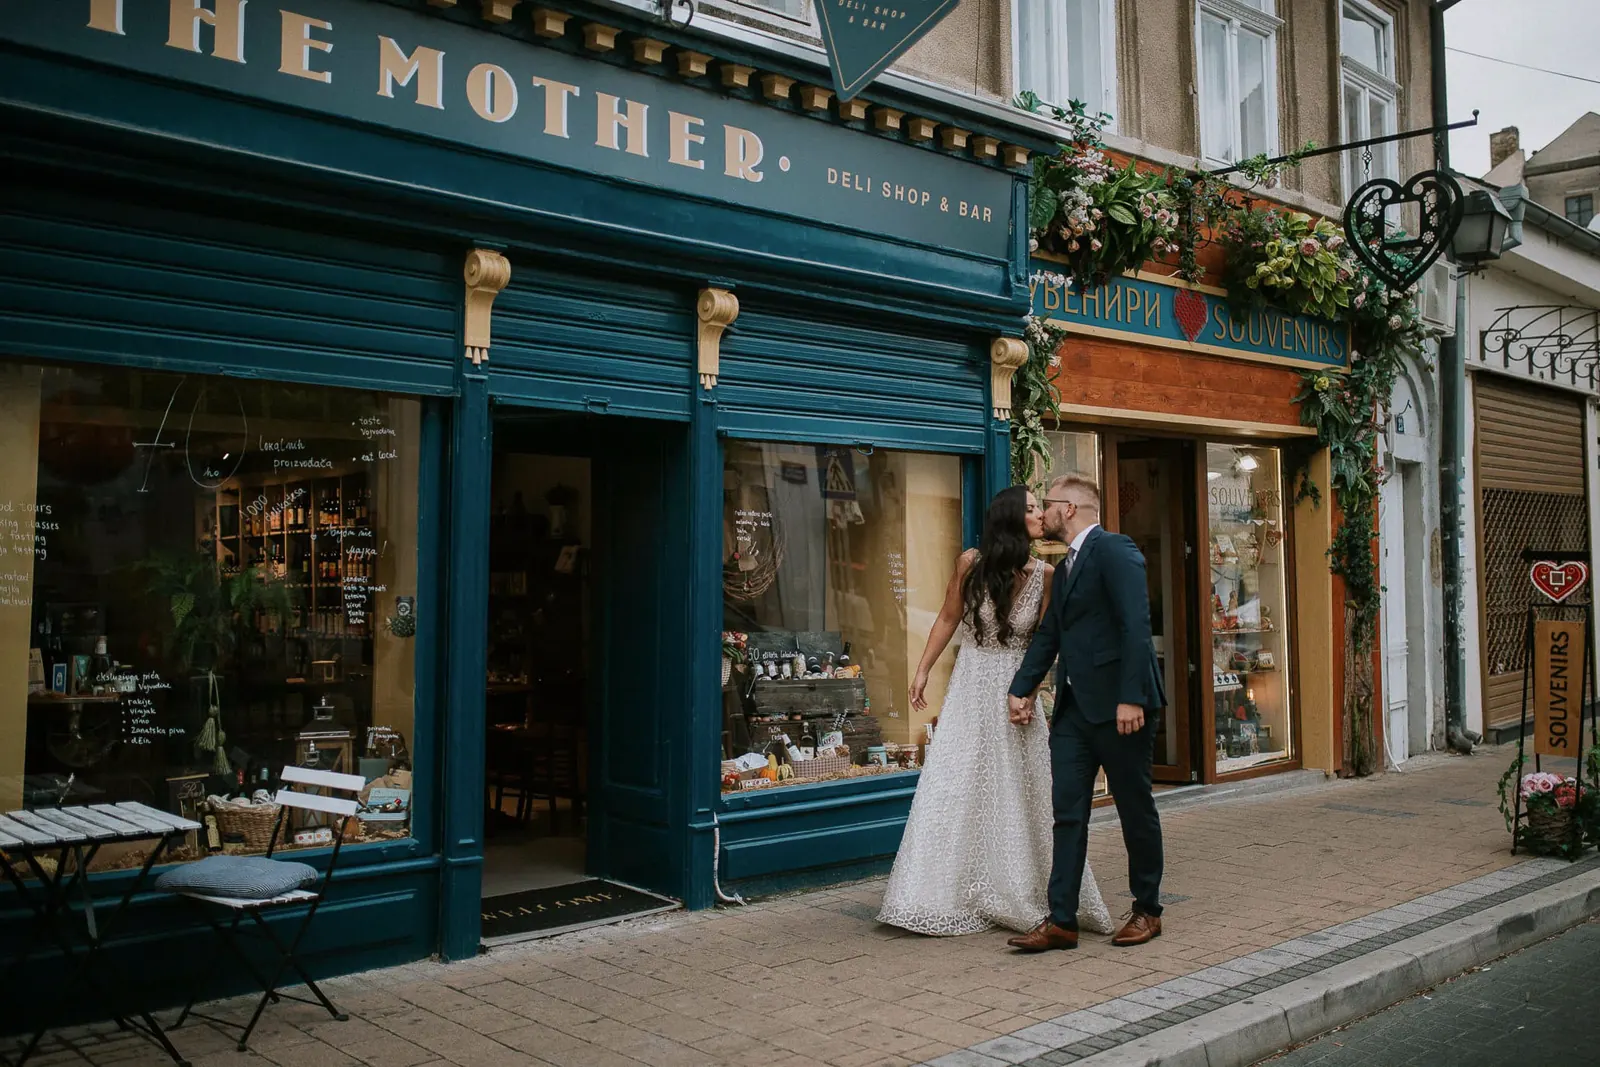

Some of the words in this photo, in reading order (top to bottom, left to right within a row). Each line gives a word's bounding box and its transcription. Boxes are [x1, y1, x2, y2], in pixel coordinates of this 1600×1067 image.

[874, 6, 906, 19] SHOP
[862, 18, 888, 31] BAR
[827, 167, 871, 194] DELI
[881, 181, 932, 207] SHOP
[939, 196, 949, 213] &
[959, 201, 993, 223] BAR
[1212, 303, 1344, 360] SOUVENIRS
[361, 452, 375, 462] eat
[378, 448, 398, 460] local
[18, 502, 52, 515] tours
[1550, 631, 1569, 748] SOUVENIRS
